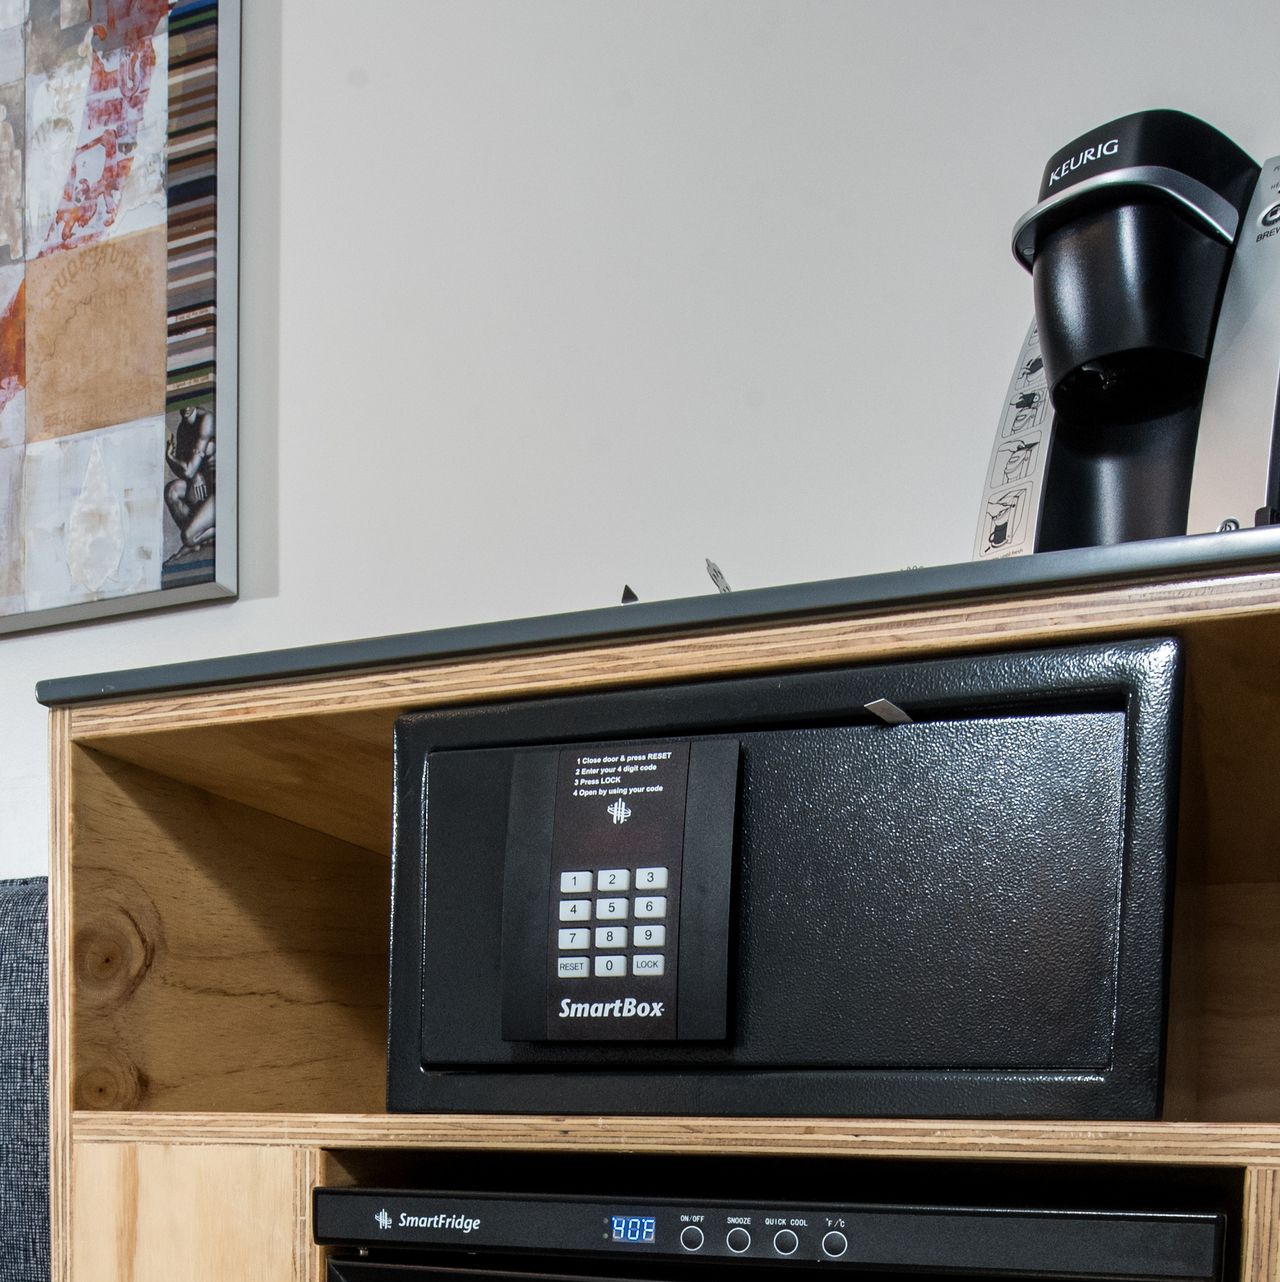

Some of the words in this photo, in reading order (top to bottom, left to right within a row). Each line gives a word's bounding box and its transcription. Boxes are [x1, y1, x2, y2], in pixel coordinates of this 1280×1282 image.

[1048, 138, 1119, 187] KEURIG
[627, 754, 646, 763] press
[647, 752, 672, 760] RESET
[575, 768, 580, 776] 2
[600, 767, 616, 775] your
[623, 764, 639, 773] digit
[640, 763, 657, 771] code
[574, 778, 579, 786] 3
[600, 776, 622, 784] LOCK
[579, 789, 597, 797] Open
[598, 788, 607, 797] by
[608, 787, 628, 795] using
[629, 786, 645, 795] your
[572, 876, 577, 886] 1
[609, 874, 616, 885] 2
[647, 872, 654, 883] 3
[570, 904, 577, 914] 4
[608, 902, 615, 913] 5
[645, 901, 653, 911] 6
[569, 933, 576, 943] 7
[606, 931, 614, 942] 8
[644, 929, 652, 940] 9
[559, 962, 584, 971] RESET
[605, 960, 613, 971] 0
[636, 960, 659, 969] LOCK
[558, 998, 664, 1018] SmartBox
[398, 1212, 481, 1233] SmartFridge
[680, 1215, 705, 1223] ON/OFF
[727, 1217, 752, 1225] SNOOZE
[765, 1218, 787, 1226] QUICK
[790, 1218, 808, 1227] COOL
